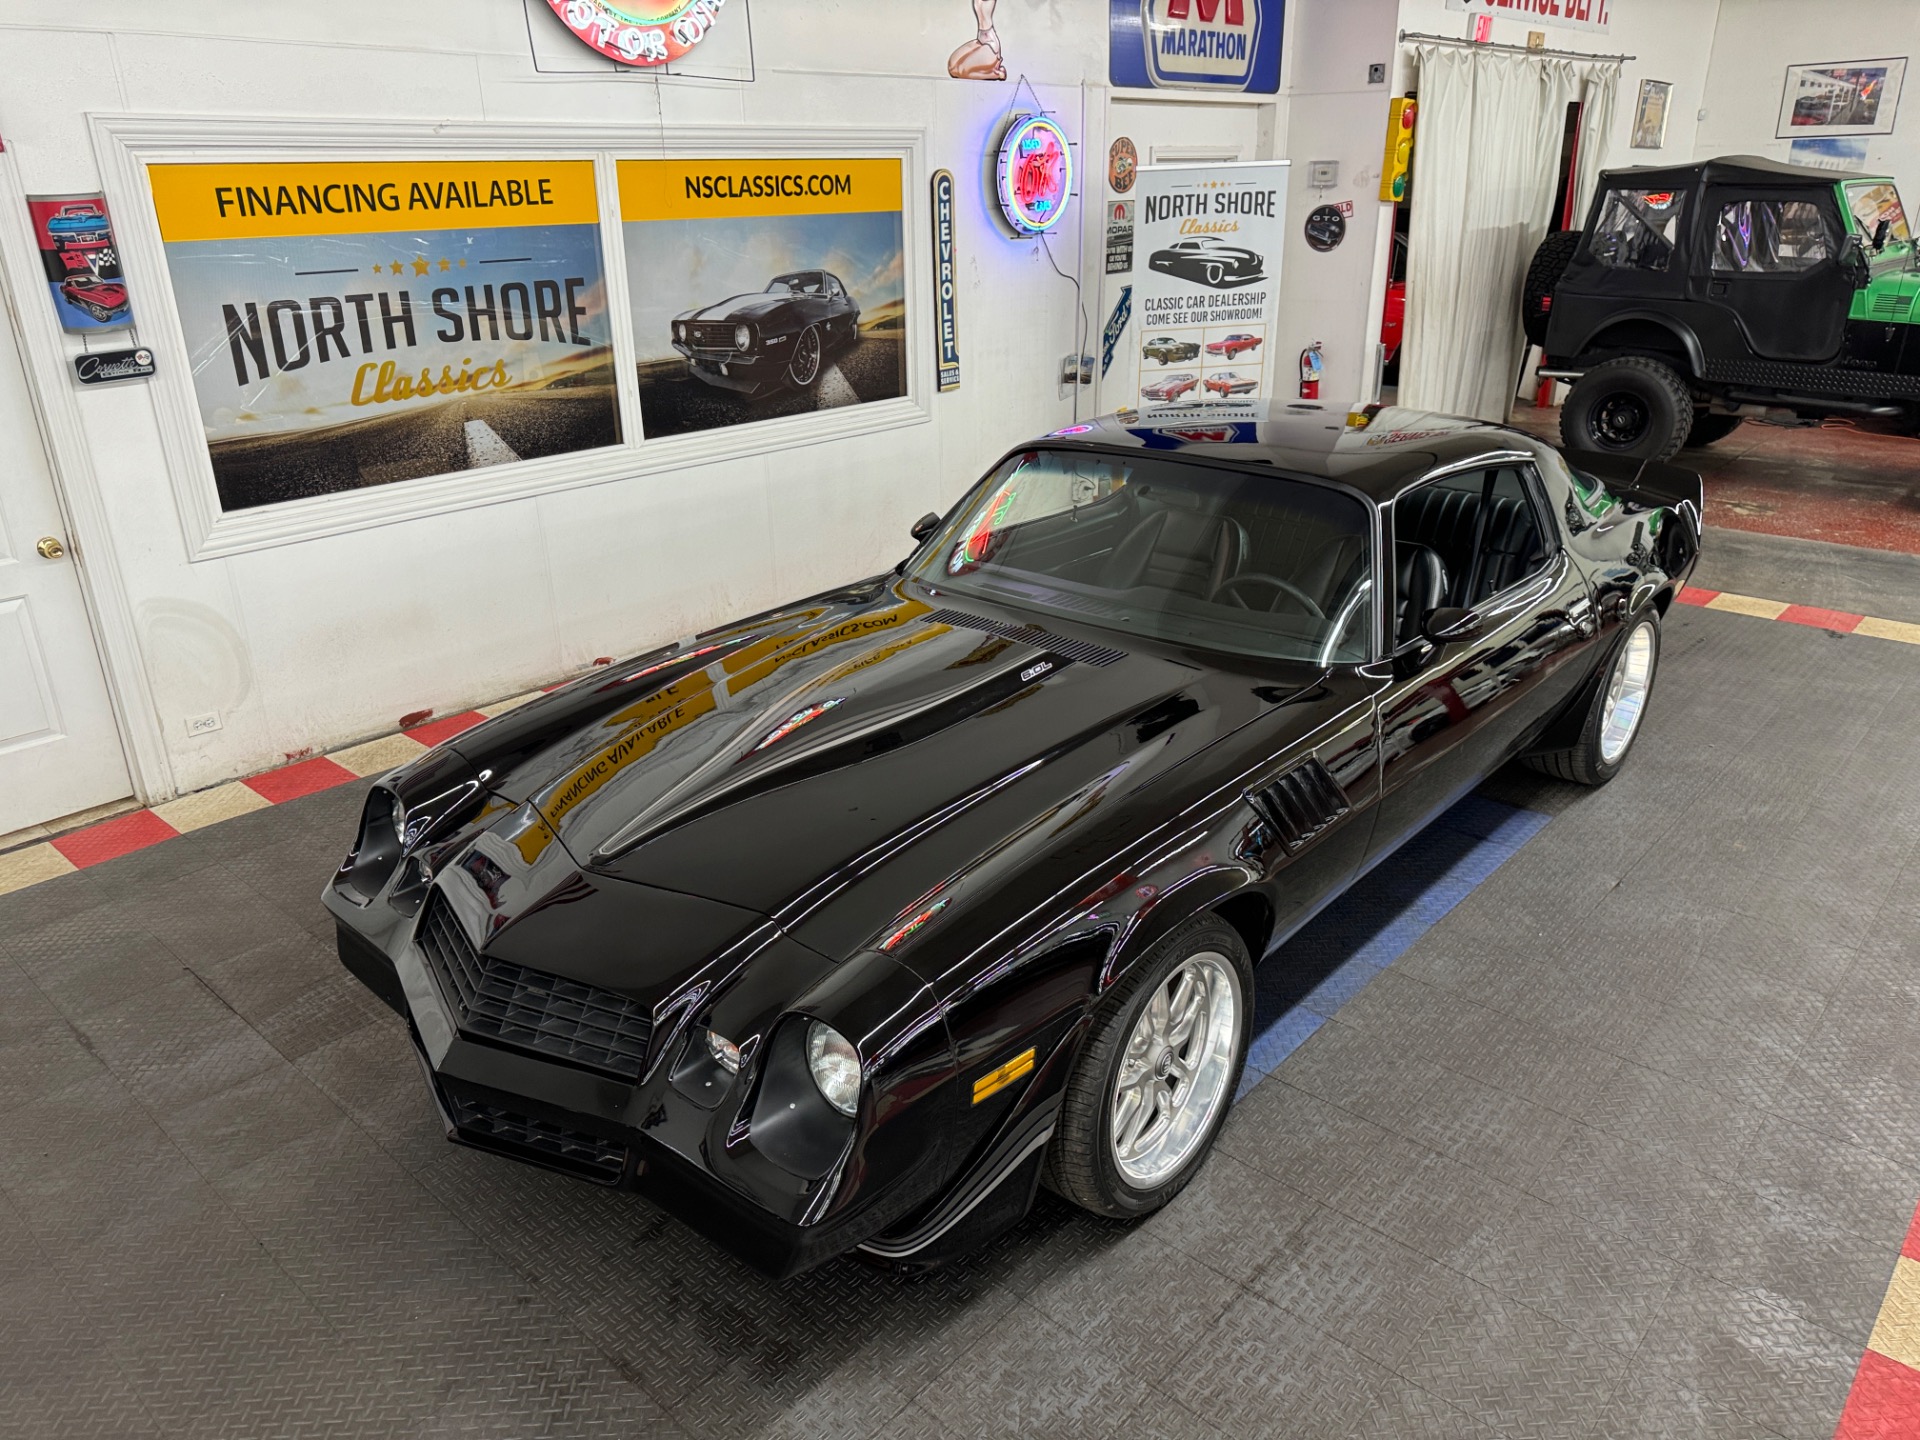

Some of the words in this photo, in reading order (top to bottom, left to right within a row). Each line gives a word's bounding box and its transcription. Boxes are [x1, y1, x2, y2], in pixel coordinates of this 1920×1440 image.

[553, 0, 668, 62] OTOR
[1160, 28, 1247, 60] MARATHON
[684, 174, 852, 199] NSCLASSICS.COM
[1114, 169, 1134, 190] BEE
[214, 182, 401, 218] FINANCING
[408, 178, 554, 211] AVAILABLE
[1144, 192, 1208, 224] NORTH
[1214, 190, 1277, 218] SHORE
[1178, 217, 1240, 235] Classics
[1312, 214, 1341, 222] GTO
[938, 181, 954, 359] CHEVROLET
[1144, 297, 1184, 312] CLASSIC
[1186, 295, 1206, 309] CAR
[1208, 292, 1267, 308] DEALERSHIP
[1107, 304, 1128, 344] Ford
[1146, 312, 1171, 326] COME
[1172, 311, 1189, 324] SEE
[1191, 310, 1208, 323] OUR
[1209, 308, 1263, 321] SHOWROOM!
[222, 290, 417, 387] NORTH
[432, 277, 592, 347] SHORE
[78, 356, 138, 380] Corvette
[350, 357, 513, 407] Classics
[1020, 661, 1053, 682] 6.0L
